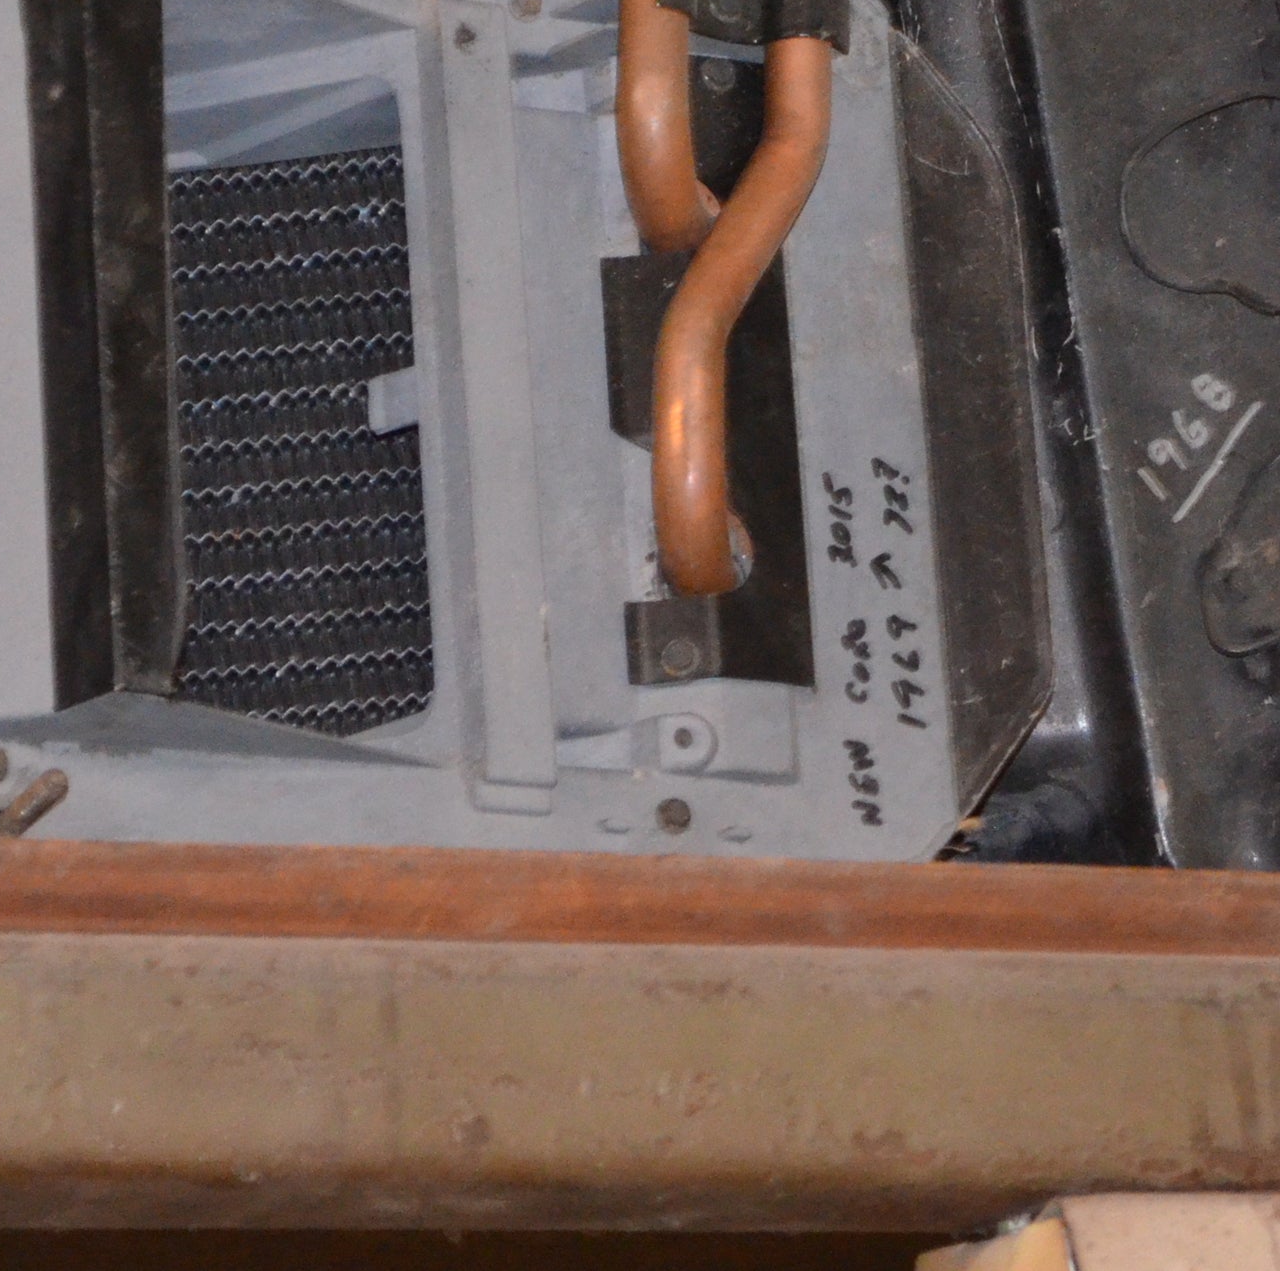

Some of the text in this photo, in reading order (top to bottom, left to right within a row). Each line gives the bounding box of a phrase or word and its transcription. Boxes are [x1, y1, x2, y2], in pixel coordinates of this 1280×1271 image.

[1137, 374, 1237, 501] 1968
[885, 613, 927, 730] 1969
[843, 739, 883, 827] NEW
